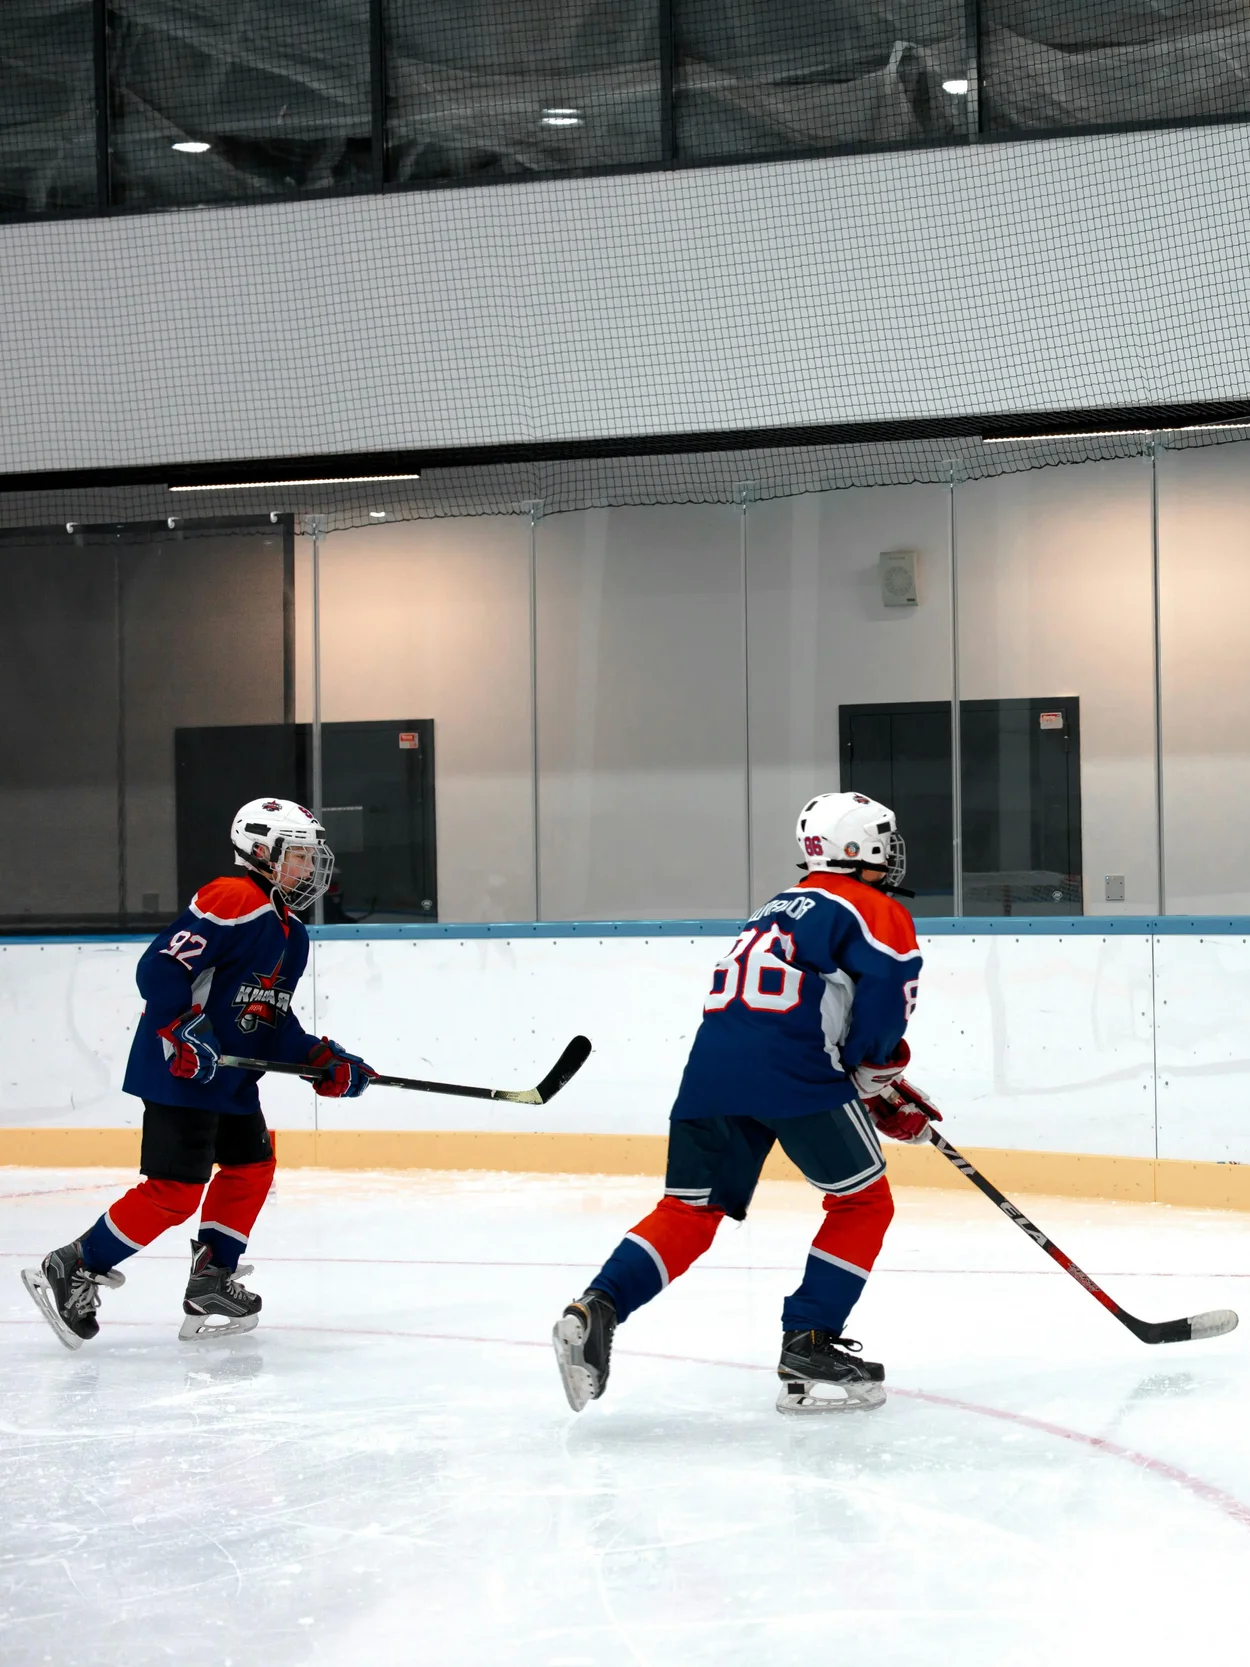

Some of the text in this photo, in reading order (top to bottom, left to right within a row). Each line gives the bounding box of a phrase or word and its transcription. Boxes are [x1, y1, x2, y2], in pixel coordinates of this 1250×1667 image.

[804, 836, 824, 856] 86
[158, 929, 208, 971] 92
[703, 921, 805, 1014] 86
